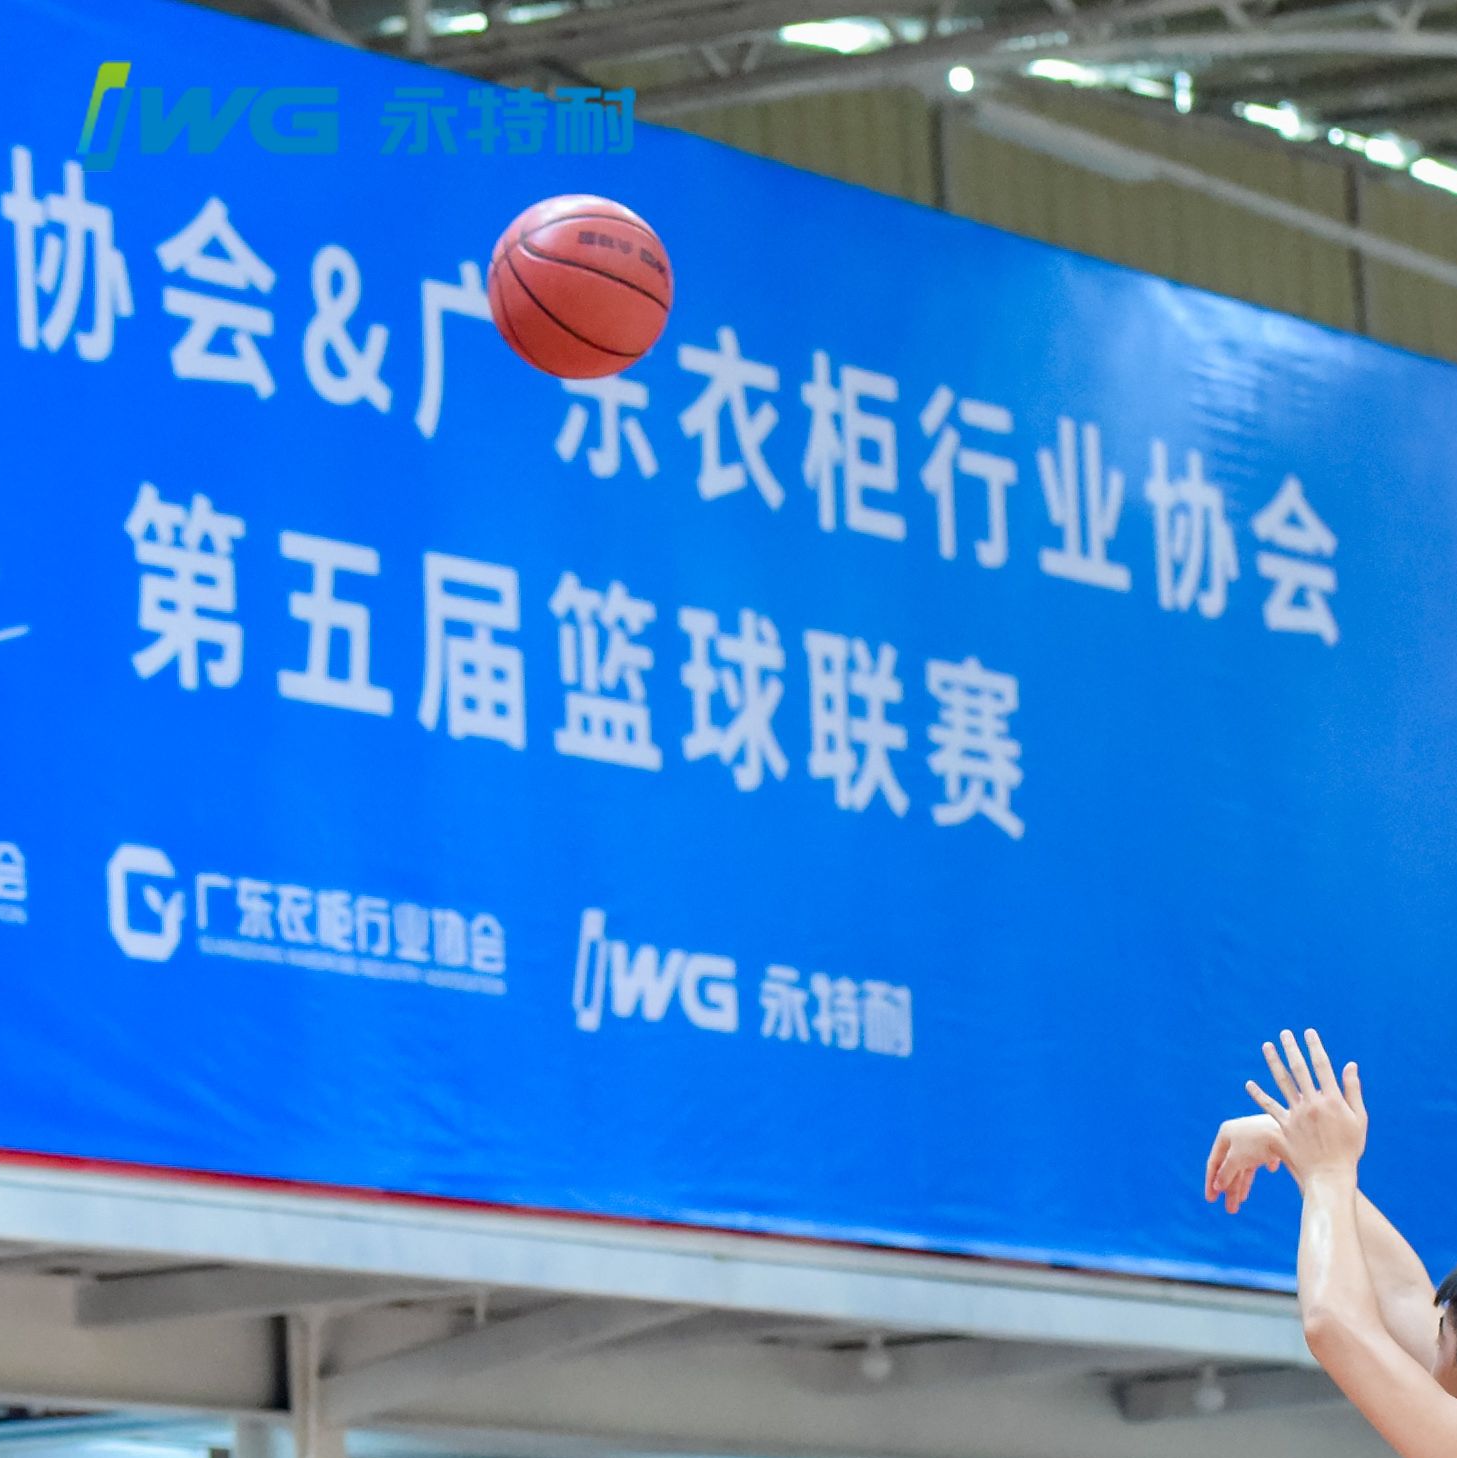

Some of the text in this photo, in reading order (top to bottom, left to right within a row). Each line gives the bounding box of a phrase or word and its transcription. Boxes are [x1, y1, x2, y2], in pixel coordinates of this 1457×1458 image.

[122, 481, 1026, 841] 第五届篮球联赛
